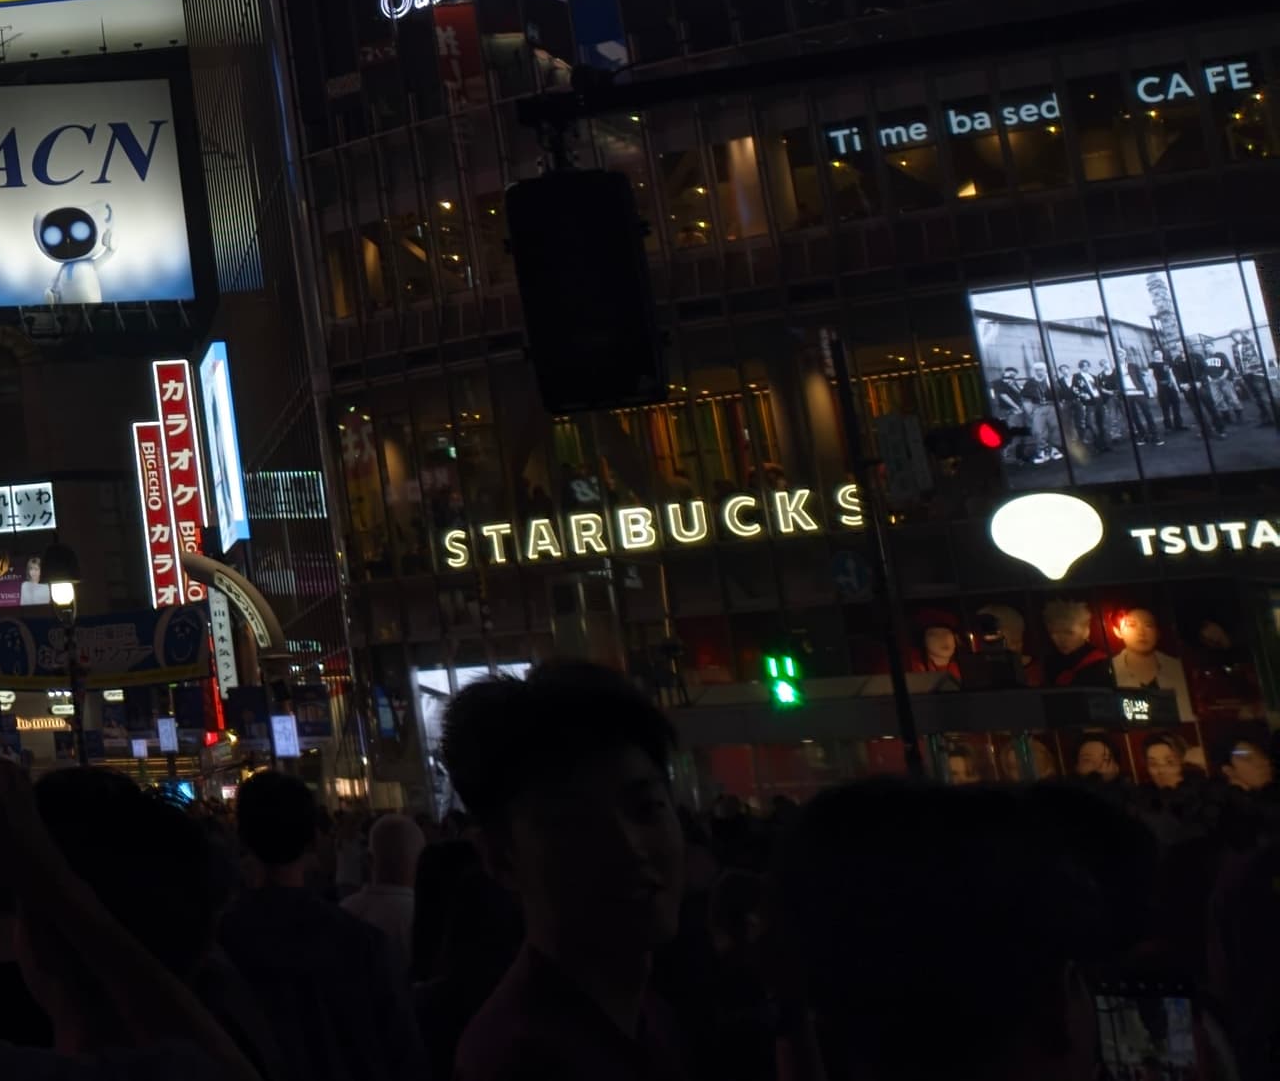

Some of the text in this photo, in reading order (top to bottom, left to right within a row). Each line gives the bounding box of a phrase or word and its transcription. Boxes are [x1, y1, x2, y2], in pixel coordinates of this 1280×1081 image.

[161, 379, 198, 508] カラオケ
[444, 483, 864, 568] STARBUCKS
